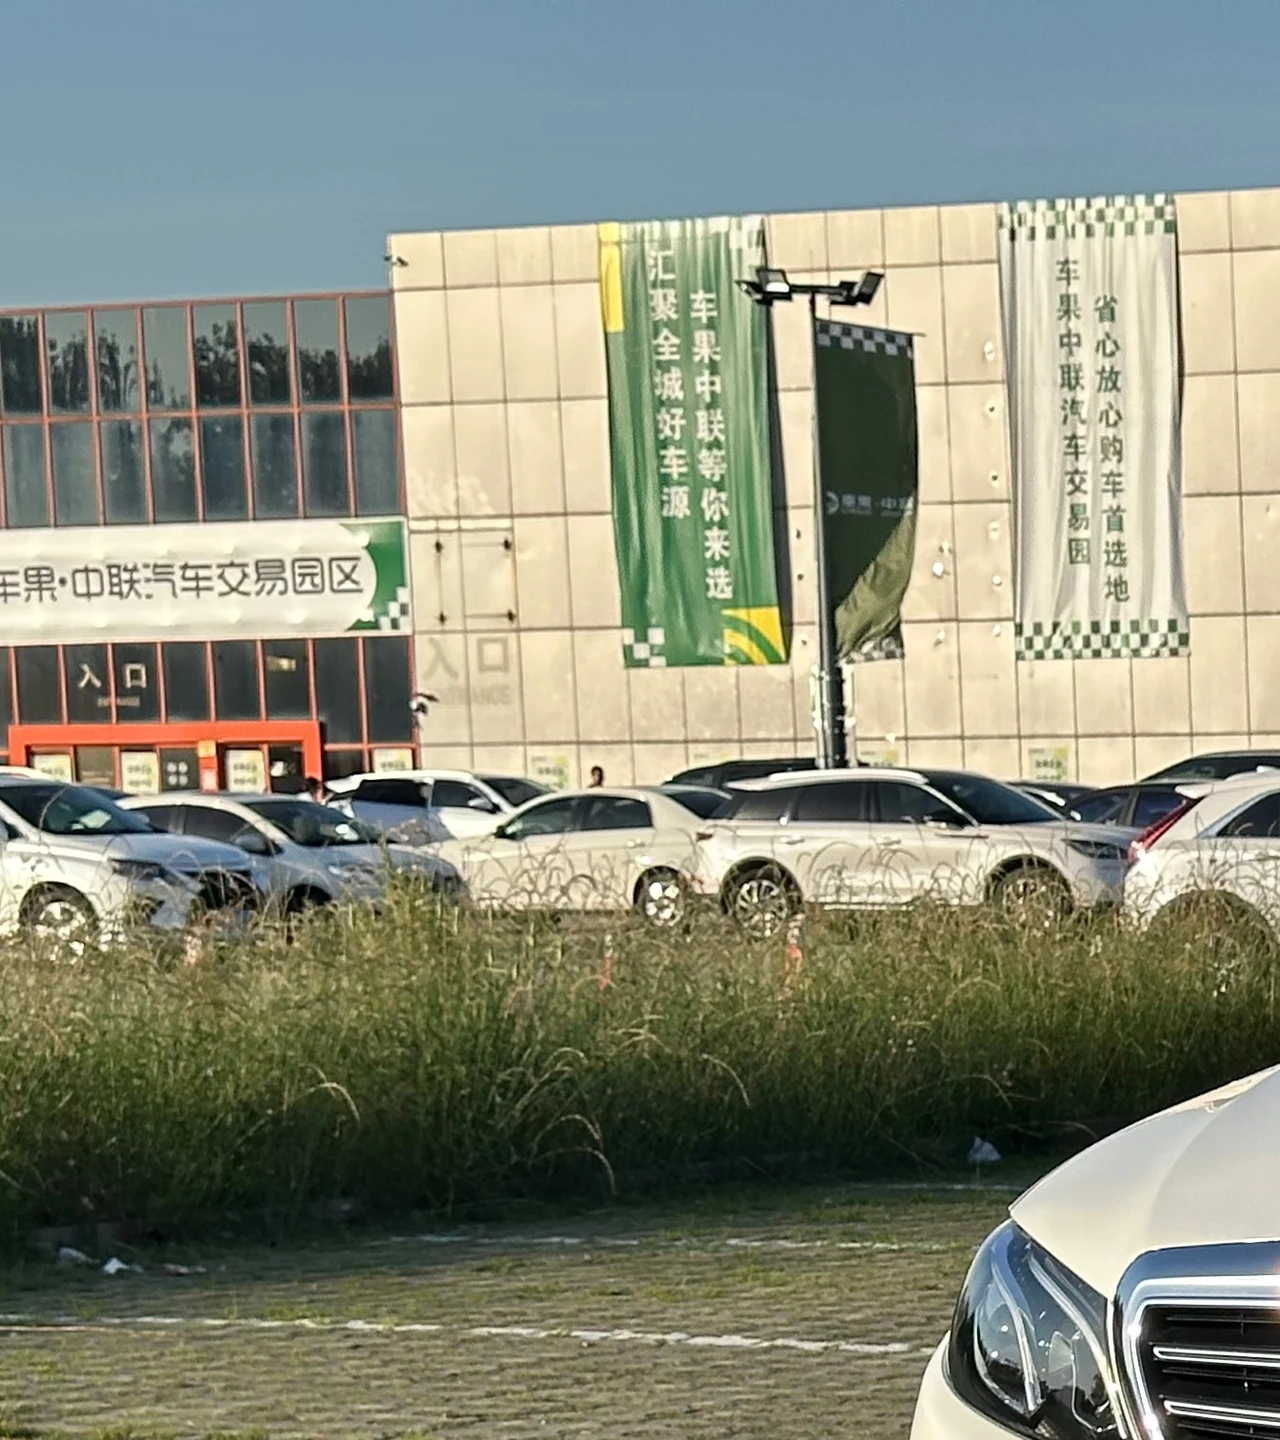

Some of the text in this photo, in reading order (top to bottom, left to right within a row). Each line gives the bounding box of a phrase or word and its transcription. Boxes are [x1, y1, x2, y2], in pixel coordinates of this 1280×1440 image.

[649, 249, 691, 519] 汇聚全城好车源
[689, 288, 733, 600] 车果中联等你来选
[1055, 256, 1091, 566] 车果中联汽车交易园
[1093, 293, 1130, 602] 省心放心购车首选地
[78, 663, 148, 689] 入口
